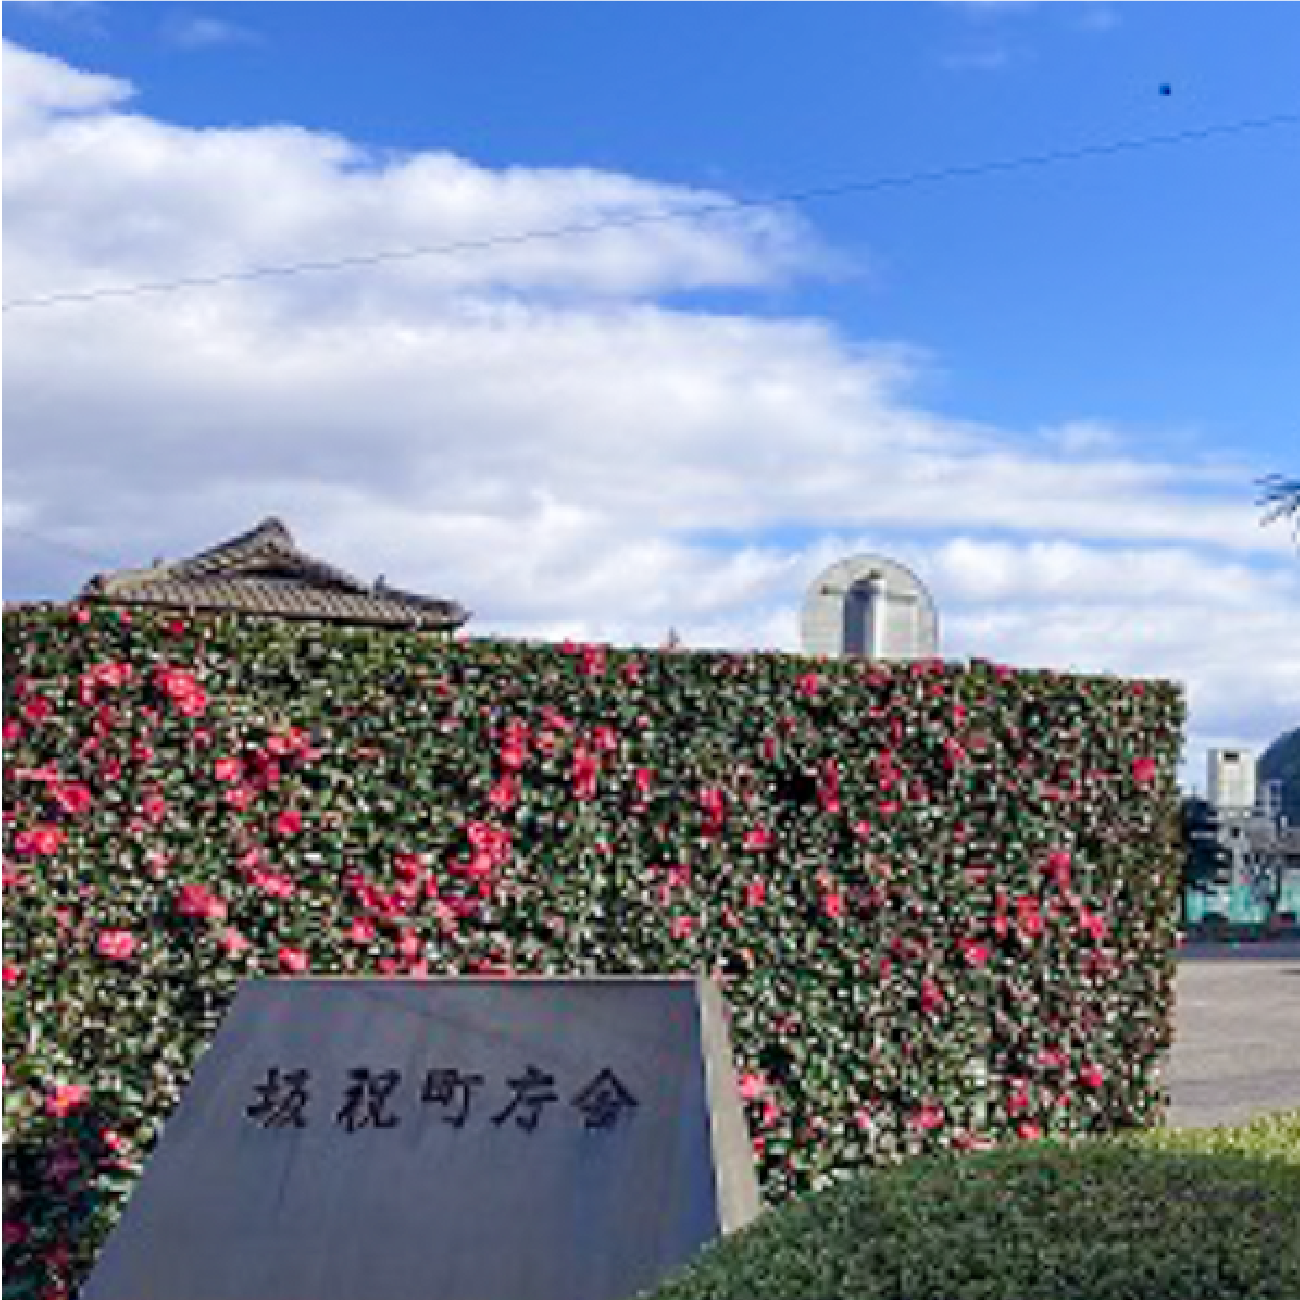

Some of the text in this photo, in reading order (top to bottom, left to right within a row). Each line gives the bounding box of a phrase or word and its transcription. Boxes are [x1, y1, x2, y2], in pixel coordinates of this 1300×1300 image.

[244, 1066, 639, 1133] 坂祝町庁舎
